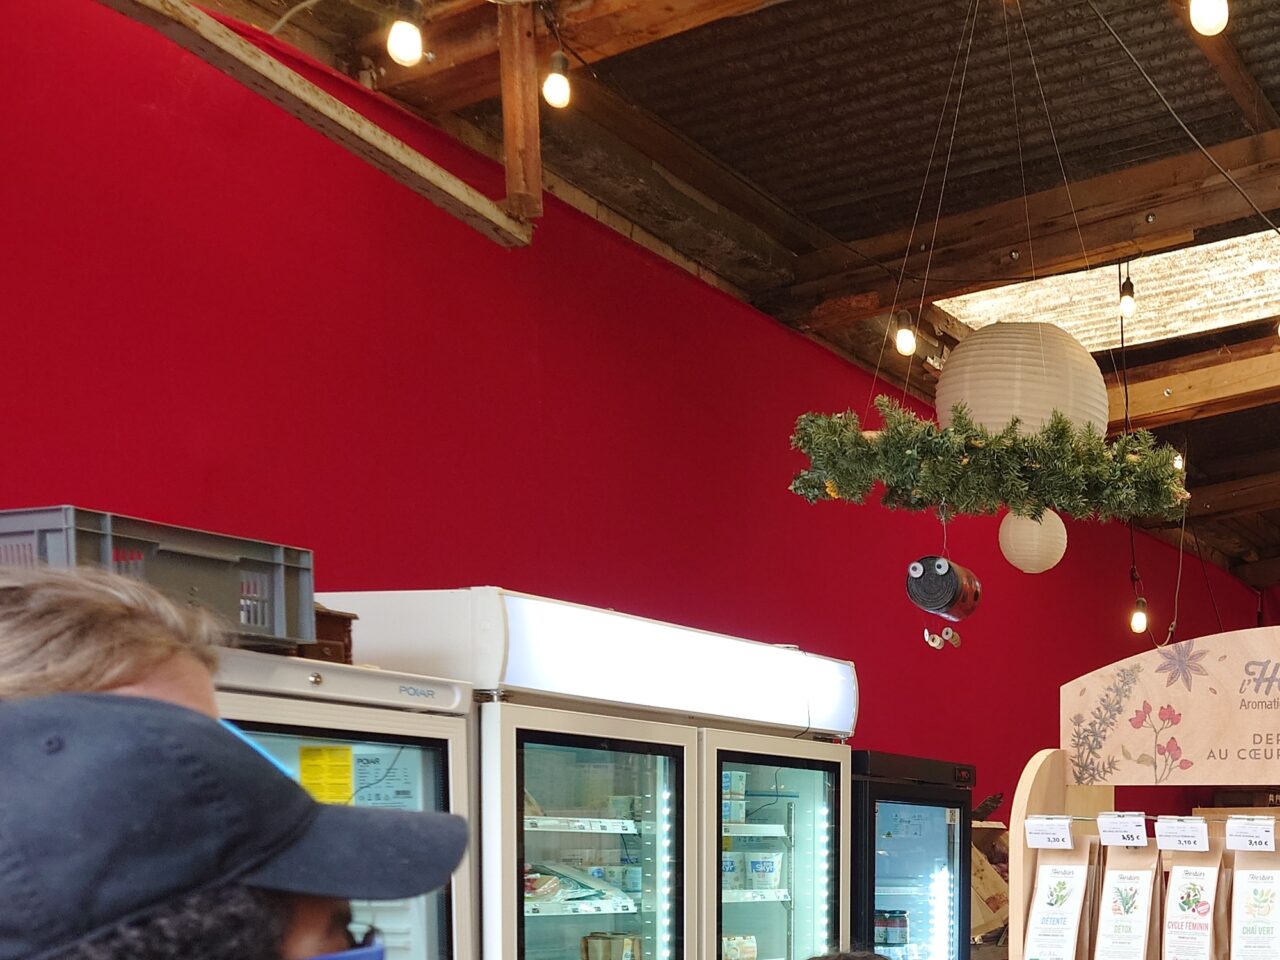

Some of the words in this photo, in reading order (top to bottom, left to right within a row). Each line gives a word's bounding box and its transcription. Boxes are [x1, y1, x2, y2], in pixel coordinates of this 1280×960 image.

[1206, 748, 1229, 760] AU
[1167, 921, 1184, 930] CYCLE
[1185, 921, 1209, 931] FÉMININ
[1258, 926, 1275, 935] VERT
